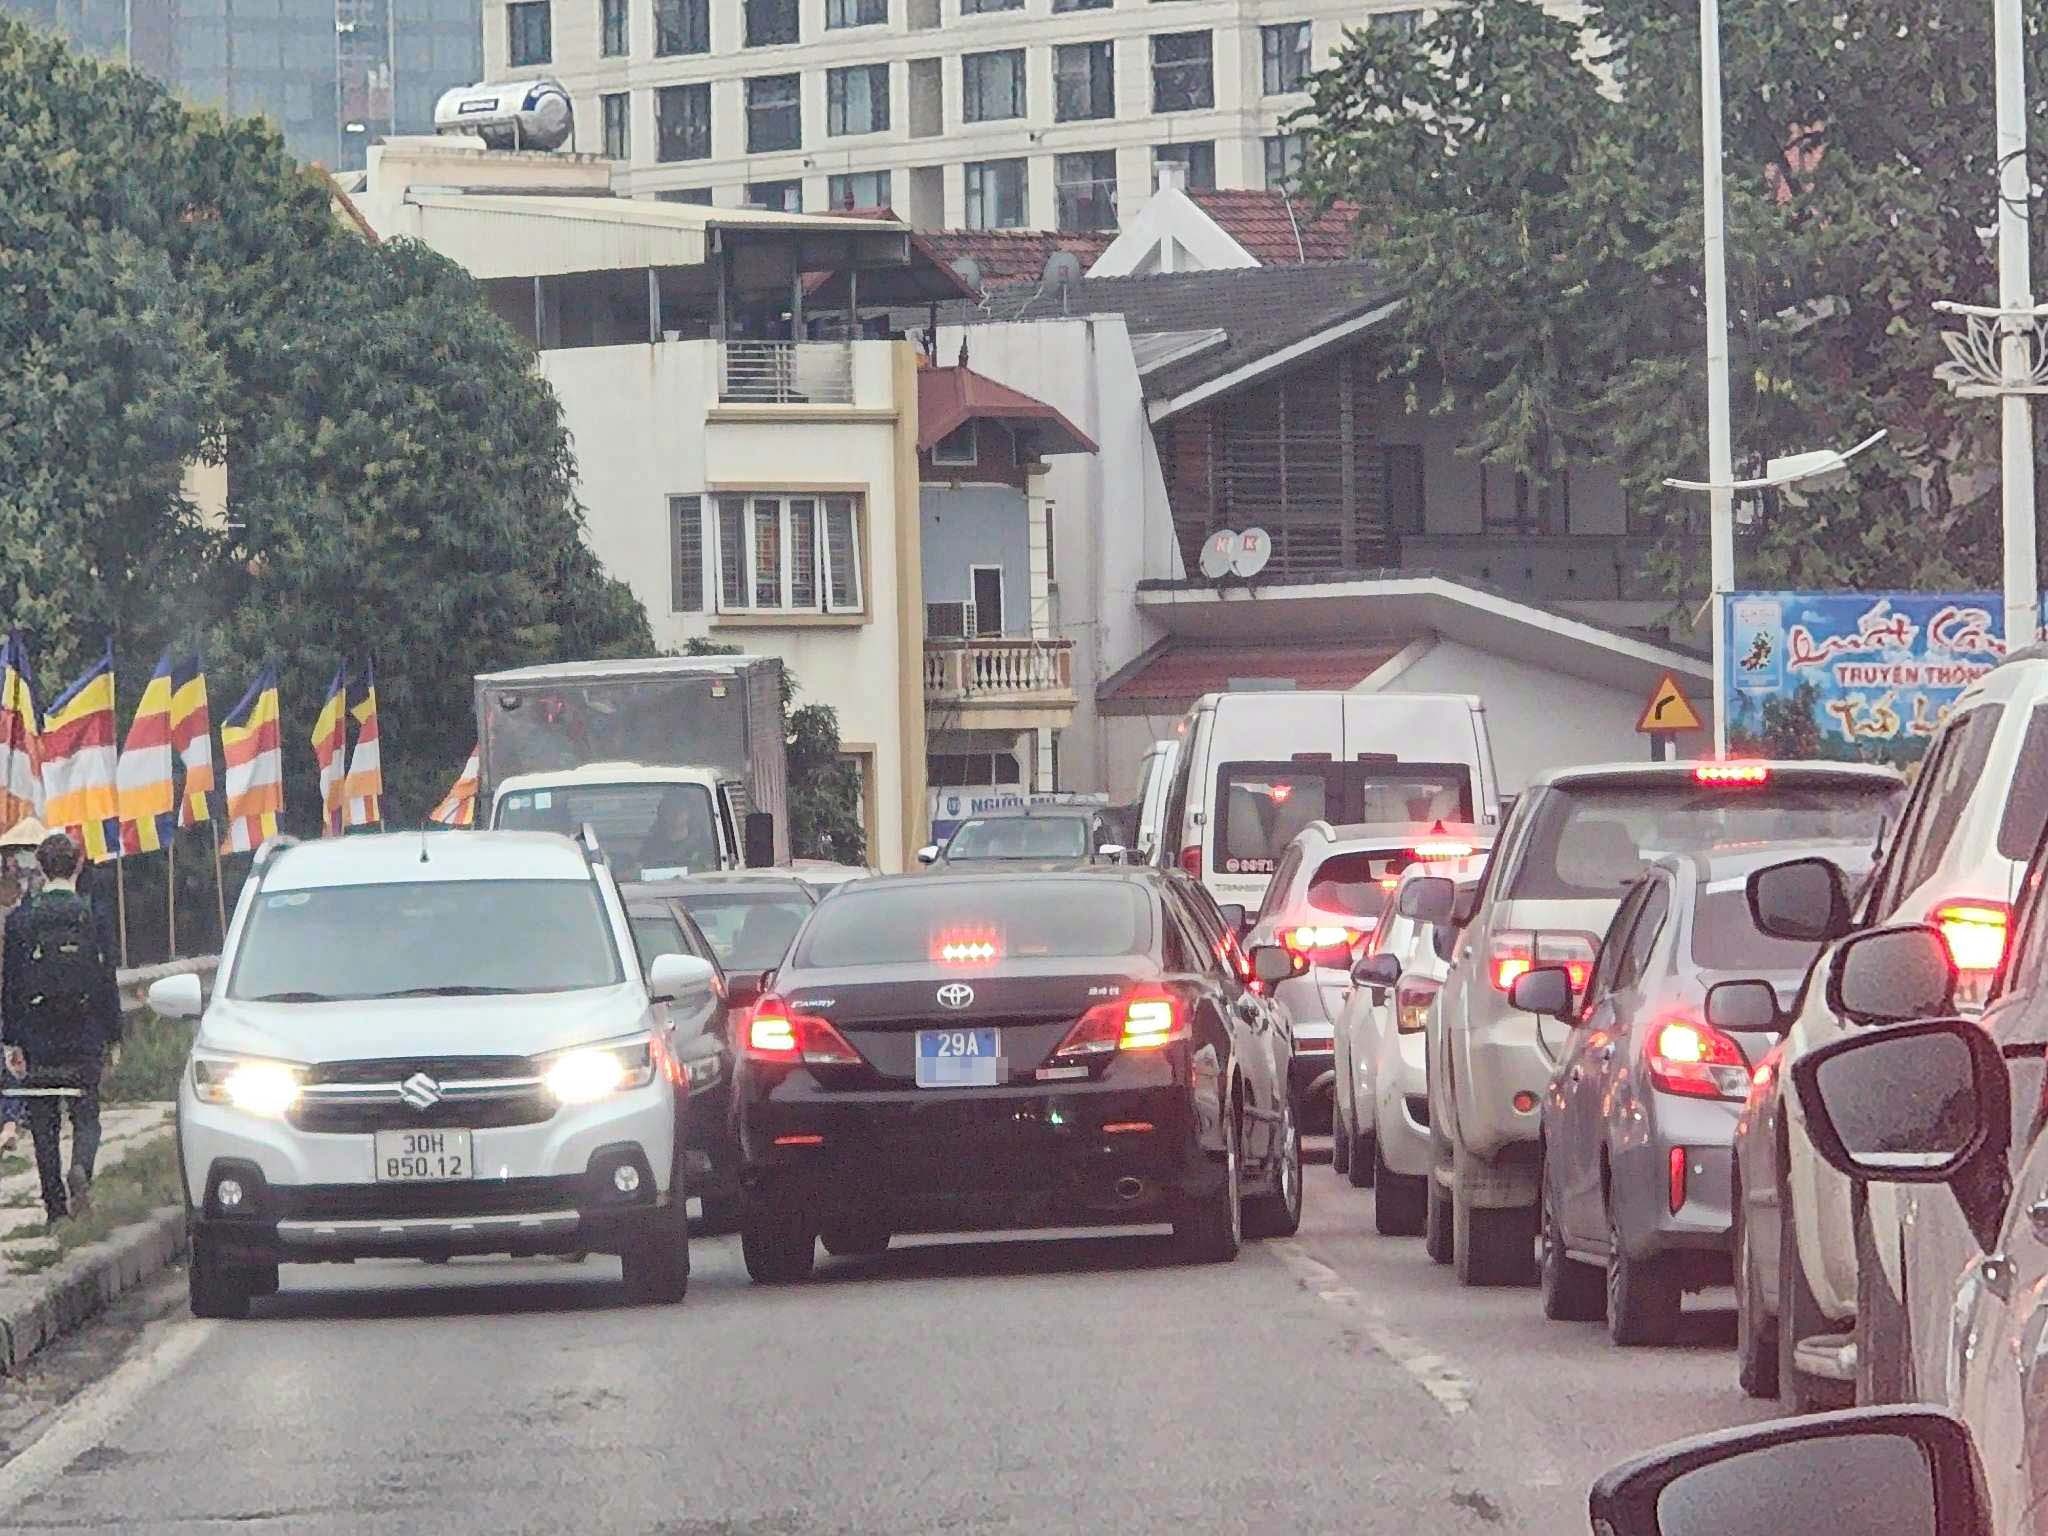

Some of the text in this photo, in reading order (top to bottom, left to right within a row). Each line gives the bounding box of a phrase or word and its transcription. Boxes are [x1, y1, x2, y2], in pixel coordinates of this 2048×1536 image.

[937, 1031, 979, 1057] 29A
[403, 1133, 444, 1154] 30H
[387, 1156, 462, 1178] 850.12
